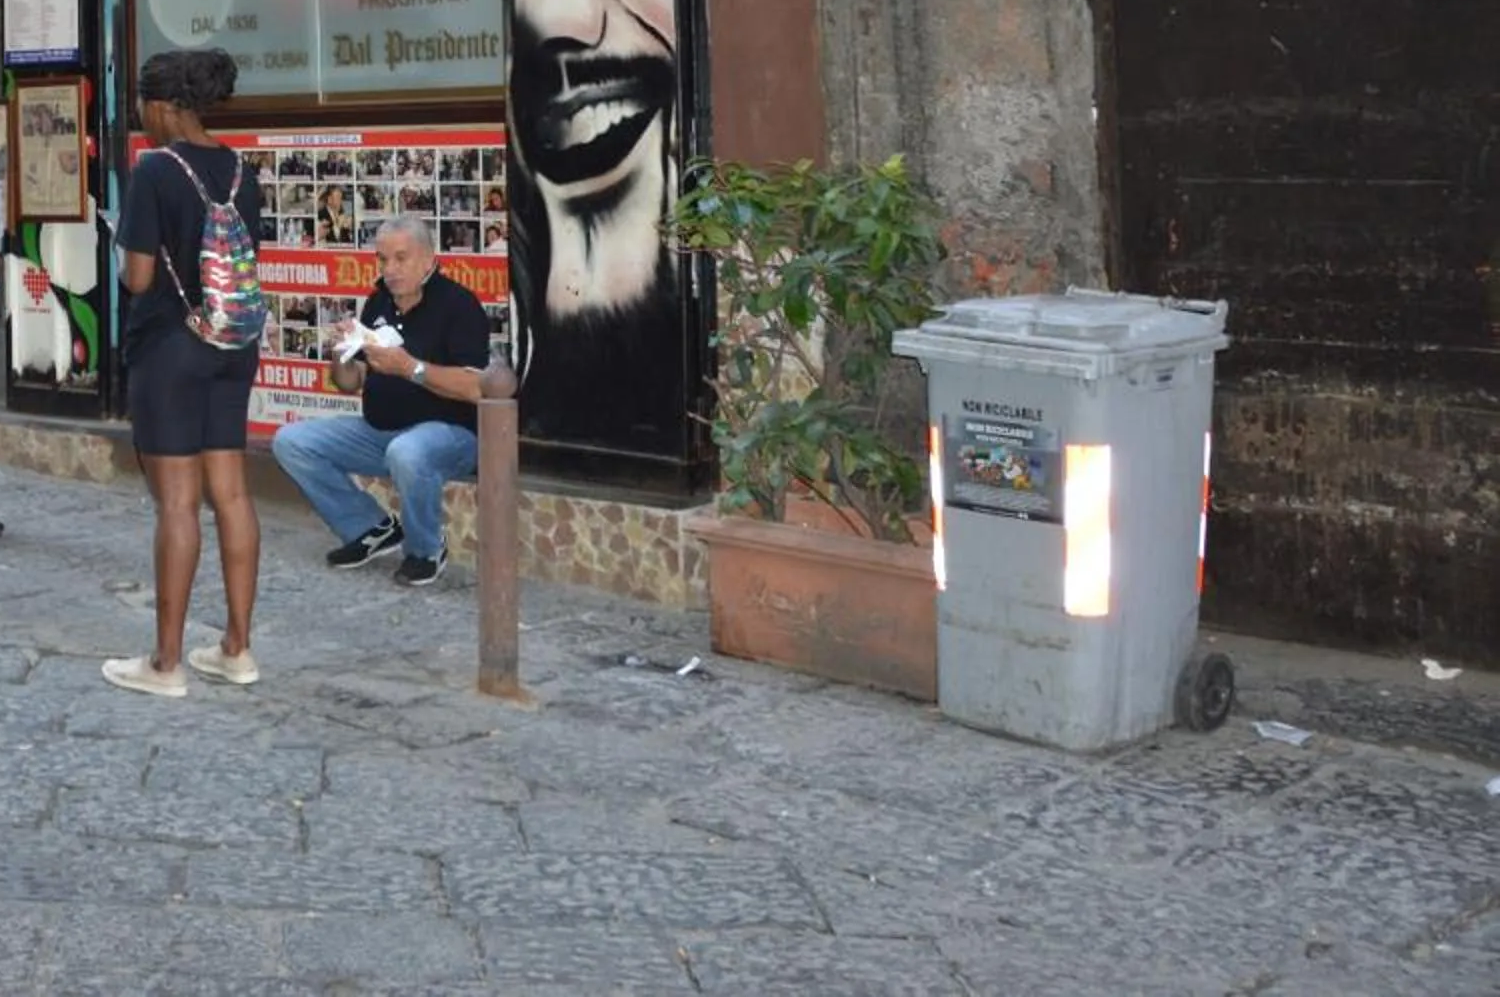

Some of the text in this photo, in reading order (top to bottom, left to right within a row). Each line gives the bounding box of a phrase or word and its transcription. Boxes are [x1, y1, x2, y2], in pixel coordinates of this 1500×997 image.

[191, 17, 216, 35] DAL
[332, 27, 500, 72] Dal Presidente
[263, 364, 289, 386] DEI
[291, 366, 318, 389] VIP
[962, 399, 1045, 423] NON RICICLABILE
